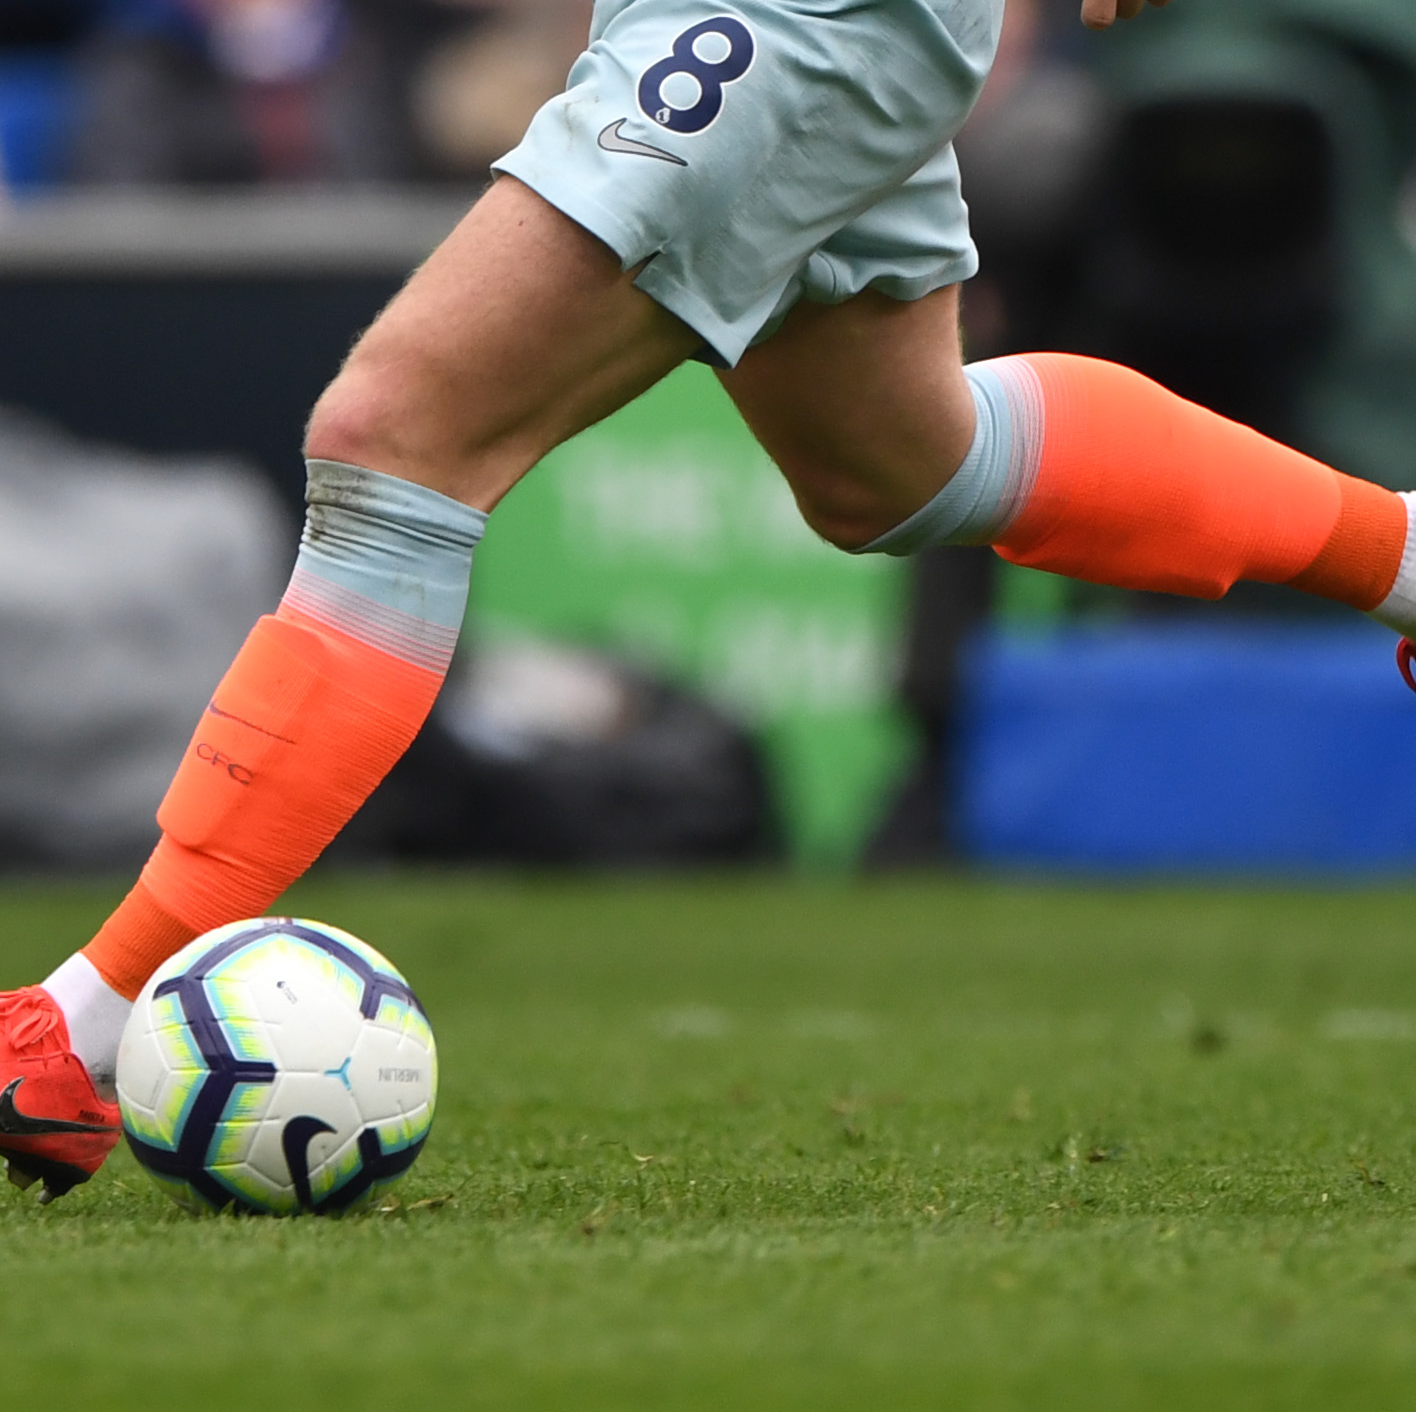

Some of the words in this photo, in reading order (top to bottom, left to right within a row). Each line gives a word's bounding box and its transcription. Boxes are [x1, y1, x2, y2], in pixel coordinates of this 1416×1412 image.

[637, 14, 756, 136] 8
[197, 743, 254, 785] CFC
[379, 1068, 421, 1082] MERLIN
